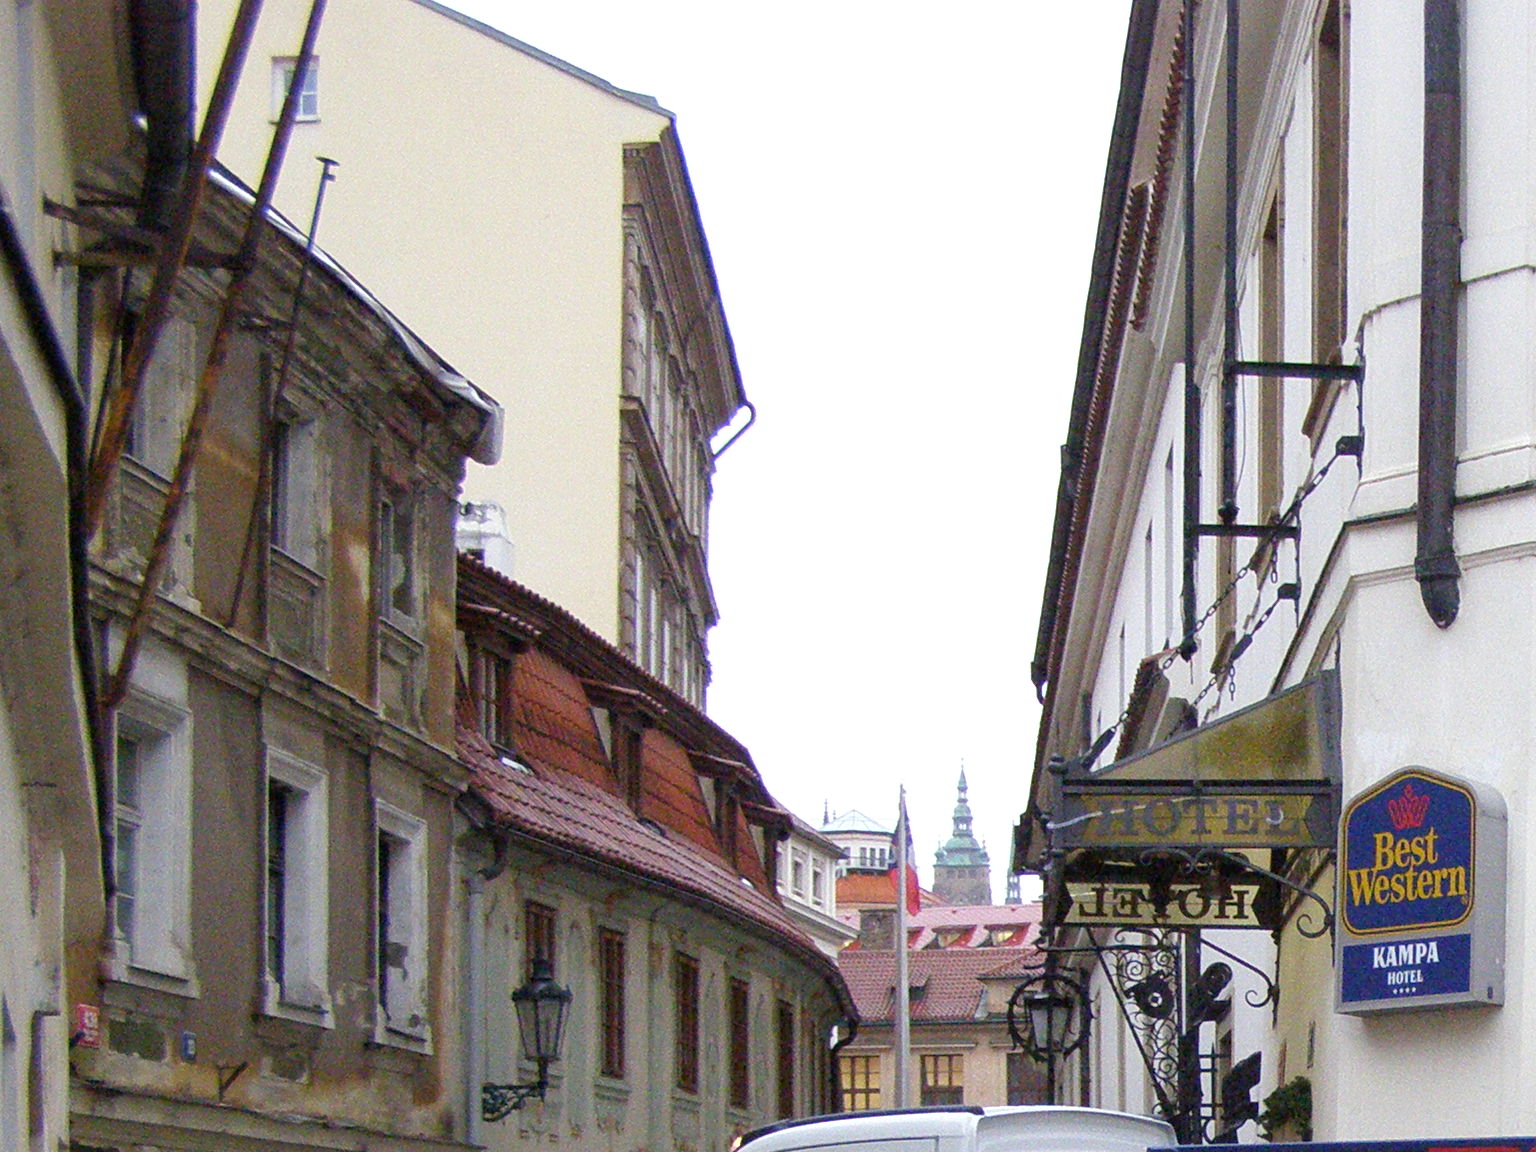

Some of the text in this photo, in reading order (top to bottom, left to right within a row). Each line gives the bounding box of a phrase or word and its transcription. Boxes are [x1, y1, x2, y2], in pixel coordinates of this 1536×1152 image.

[1094, 799, 1300, 836] HOTEL
[1373, 826, 1439, 871] Best
[1348, 864, 1468, 907] Western
[1373, 941, 1440, 969] KAMPA
[1387, 969, 1424, 986] HOTEL
